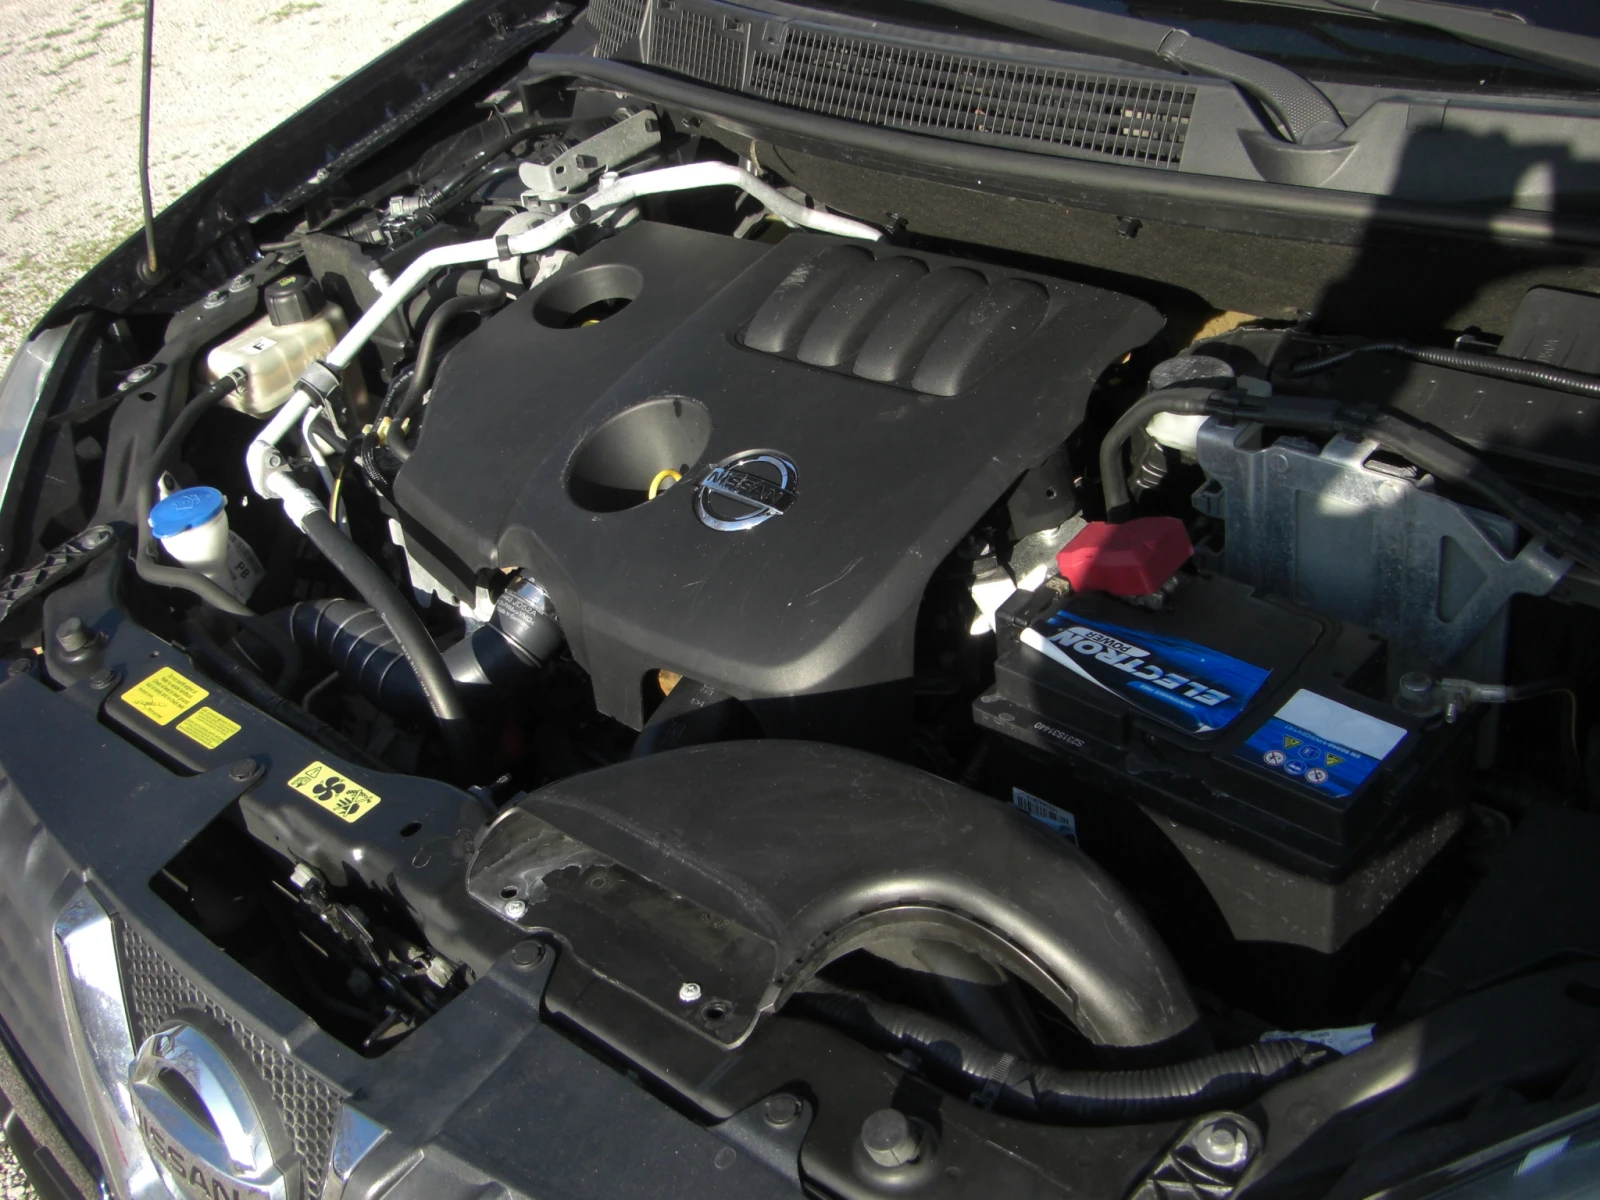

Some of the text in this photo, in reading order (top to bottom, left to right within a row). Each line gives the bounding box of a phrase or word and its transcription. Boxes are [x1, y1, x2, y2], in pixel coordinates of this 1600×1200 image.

[706, 471, 784, 502] NISSAN
[1085, 631, 1132, 653] POWER
[1049, 629, 1232, 707] ELECTRON
